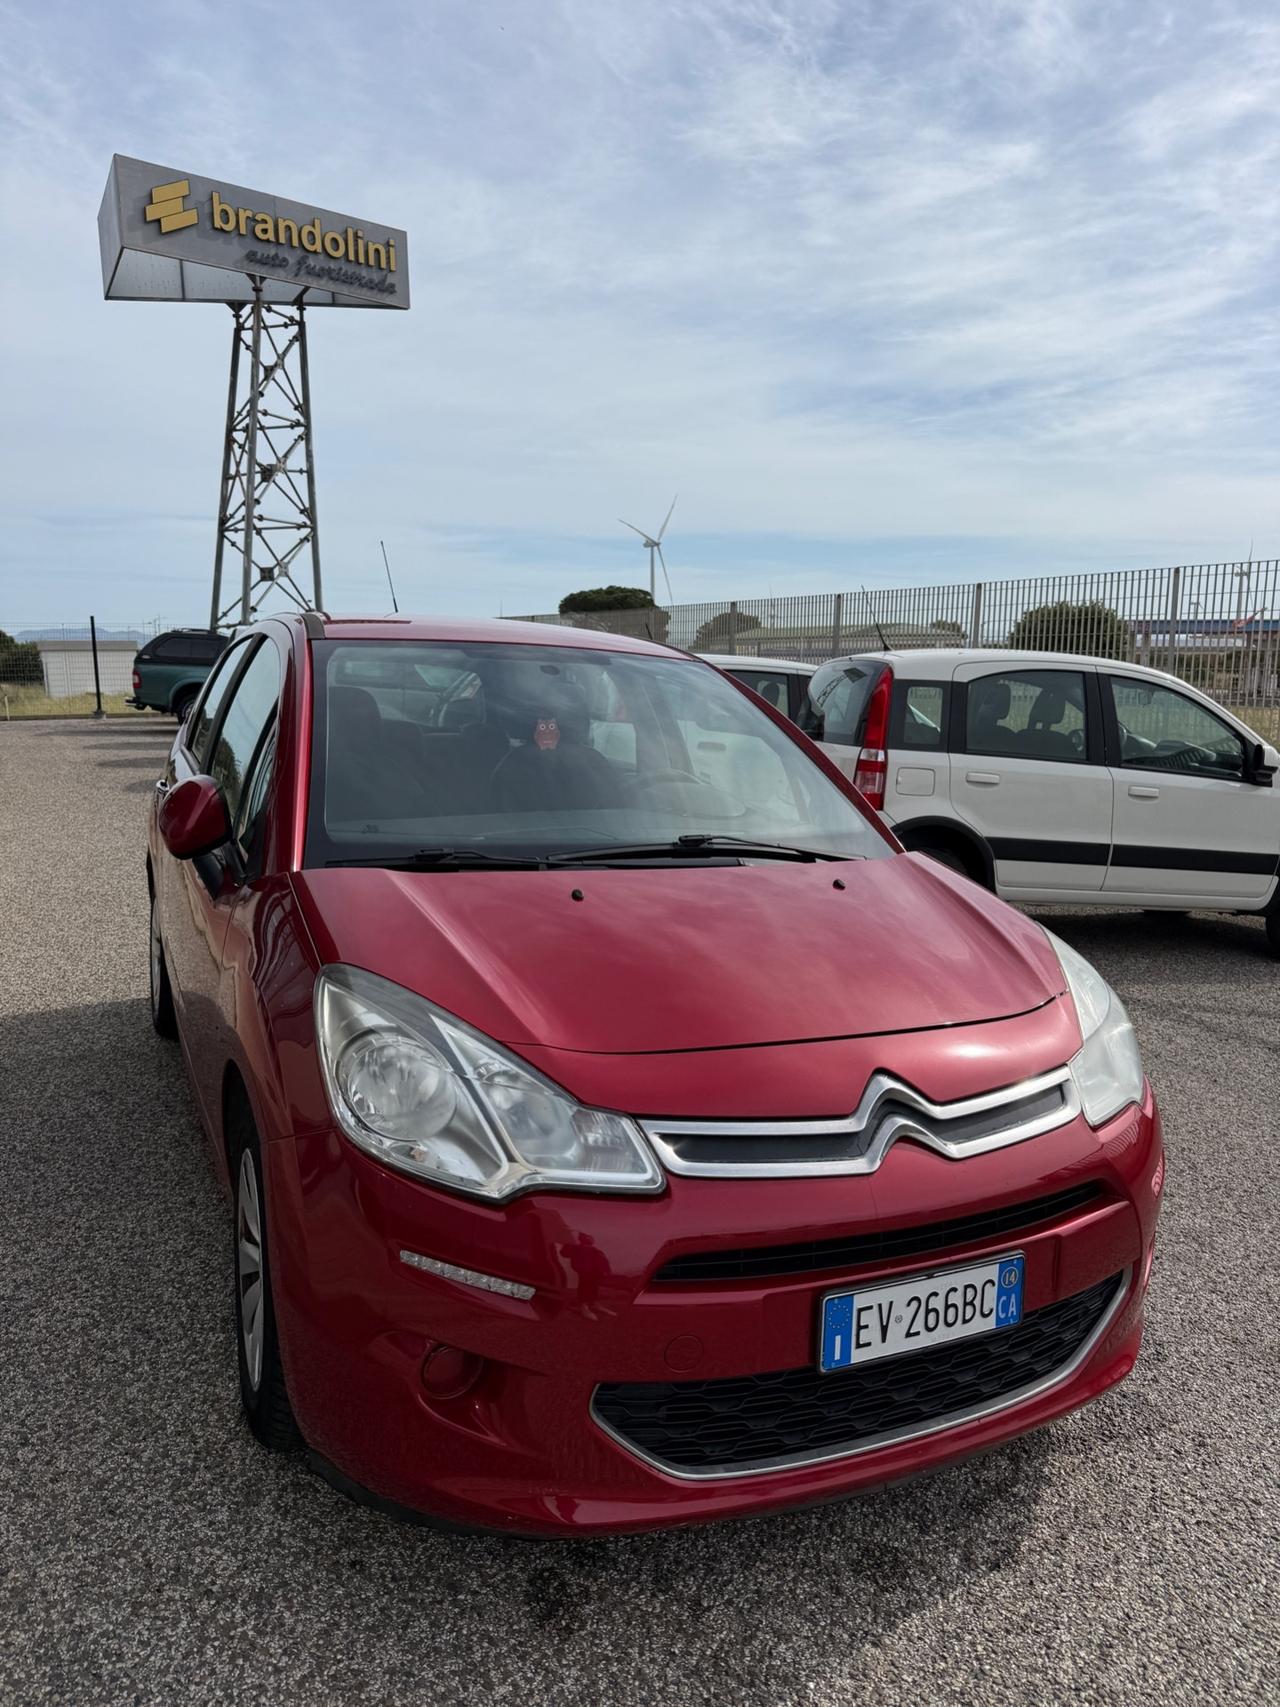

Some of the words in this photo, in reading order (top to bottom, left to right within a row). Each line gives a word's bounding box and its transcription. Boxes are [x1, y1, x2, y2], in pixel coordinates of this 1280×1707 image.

[211, 191, 397, 272] brandolini
[246, 250, 290, 267] auto
[1004, 1269, 1017, 1285] 14
[997, 1292, 1018, 1319] CA
